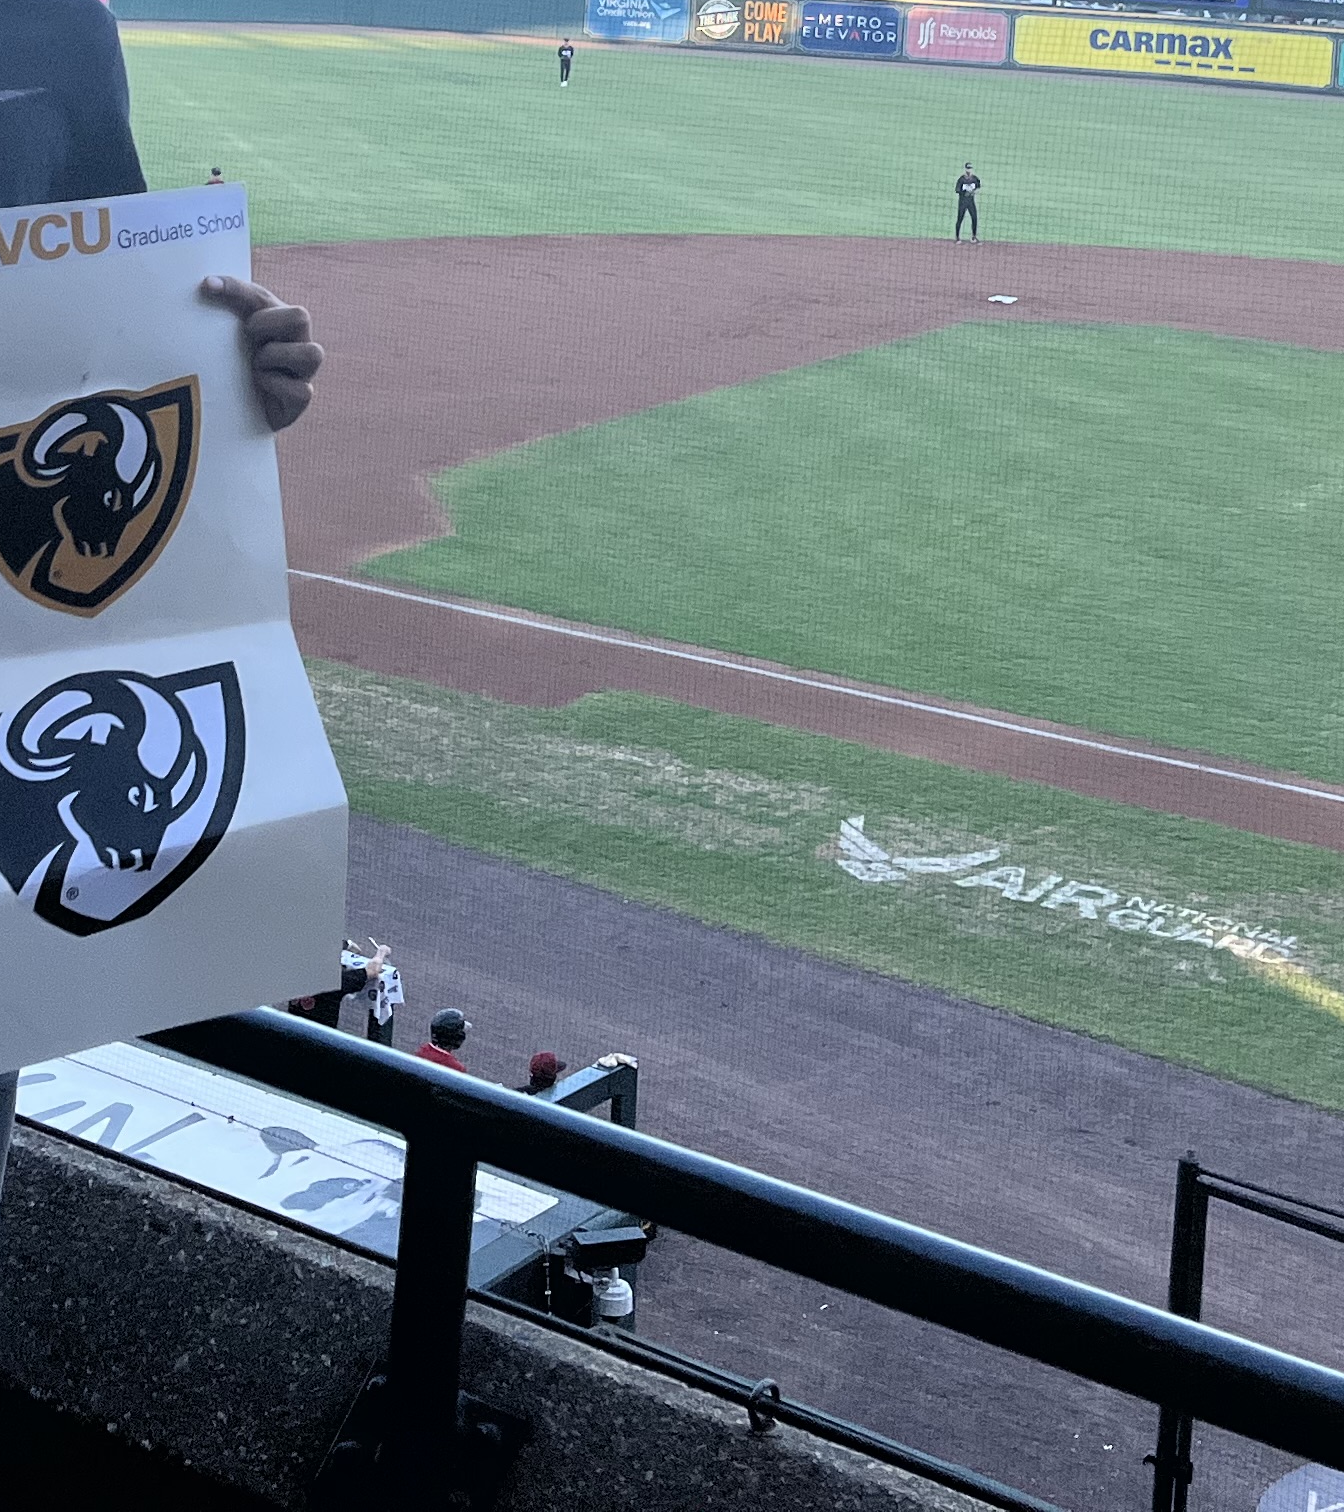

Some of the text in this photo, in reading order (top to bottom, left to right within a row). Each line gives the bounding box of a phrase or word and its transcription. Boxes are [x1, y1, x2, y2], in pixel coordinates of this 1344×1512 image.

[596, 6, 625, 18] Credit
[699, 11, 739, 26] THE PARK
[744, 0, 787, 23] COME
[818, 12, 882, 30] METRO
[744, 21, 784, 44] PLAY.
[802, 25, 897, 44] ELEVATOR
[939, 23, 997, 41] Reynolds
[117, 222, 193, 249] Graduate
[196, 210, 245, 237] School
[954, 865, 1121, 920] AIR
